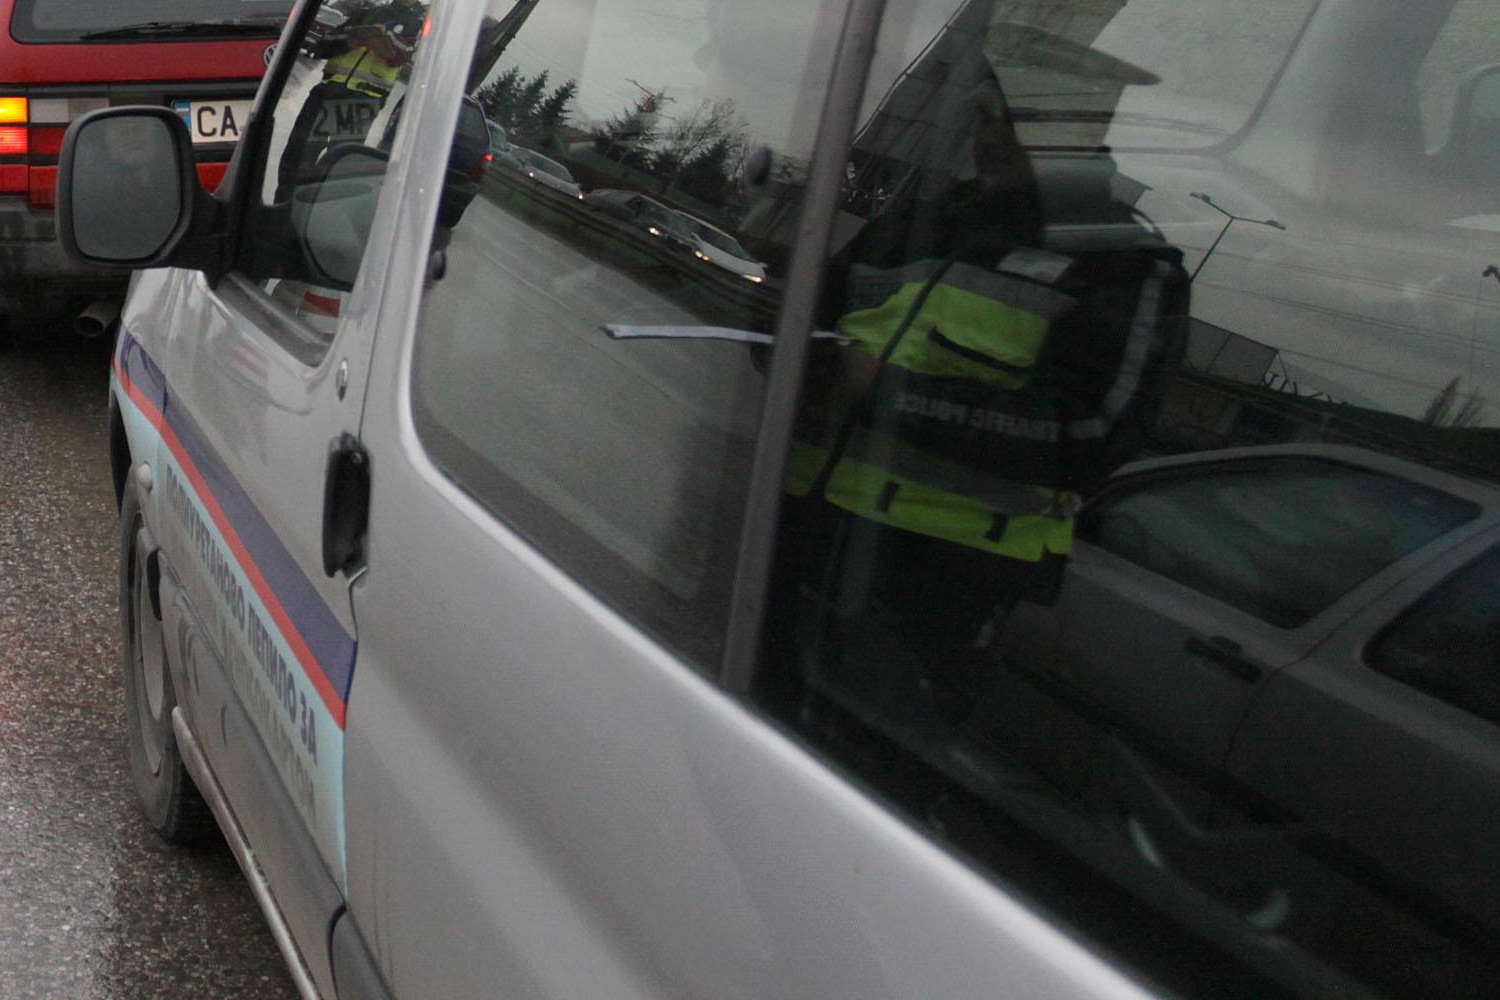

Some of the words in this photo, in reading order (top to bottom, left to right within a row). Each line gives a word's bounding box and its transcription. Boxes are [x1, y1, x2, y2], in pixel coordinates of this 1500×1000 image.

[196, 105, 239, 137] CA
[248, 599, 297, 724] ЛЕПИЛО
[300, 691, 318, 767] ЗА
